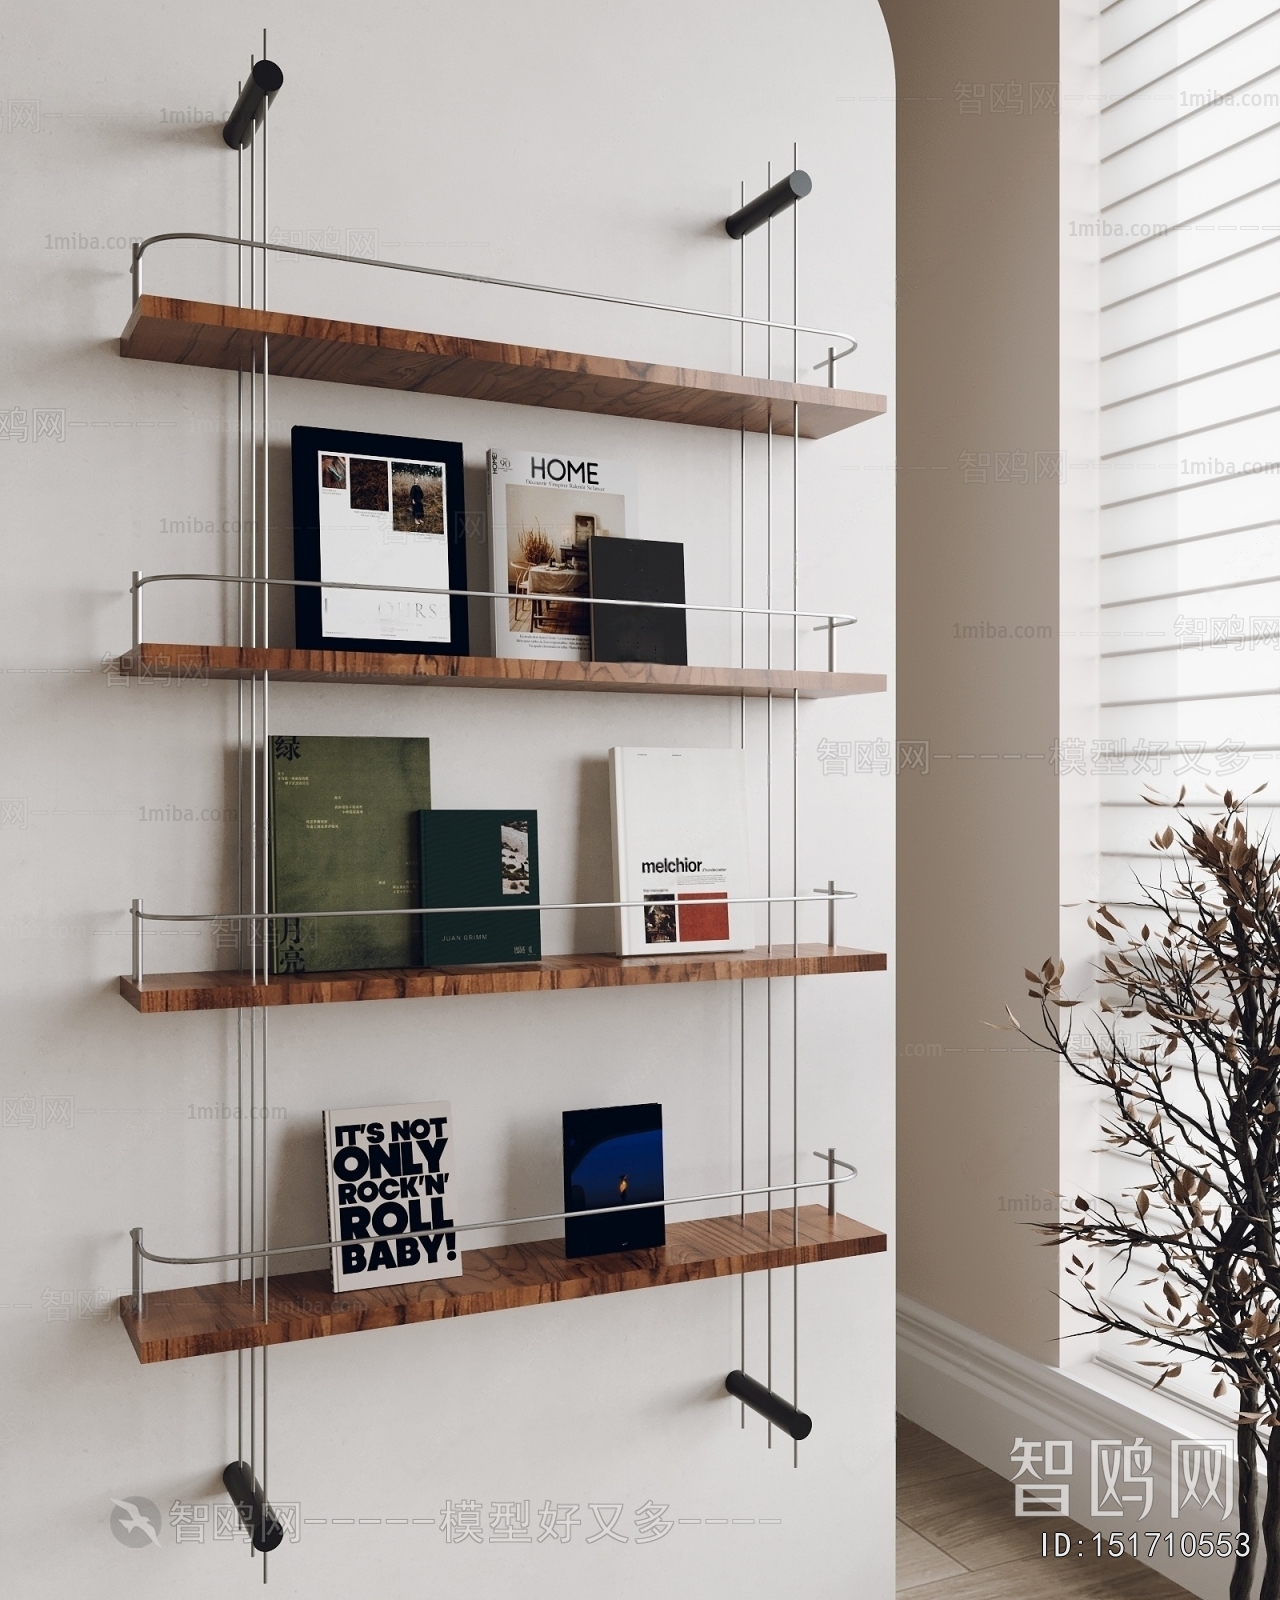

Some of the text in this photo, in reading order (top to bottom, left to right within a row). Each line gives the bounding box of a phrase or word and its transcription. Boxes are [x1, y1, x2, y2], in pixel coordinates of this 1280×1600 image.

[531, 456, 599, 485] HOME
[641, 857, 702, 874] melchior
[335, 1117, 448, 1147] IT'S NOT
[333, 1137, 449, 1182] ONLY
[338, 1173, 450, 1205] ROCK'N'
[339, 1196, 454, 1242] ROLL
[341, 1232, 457, 1274] BABY!
